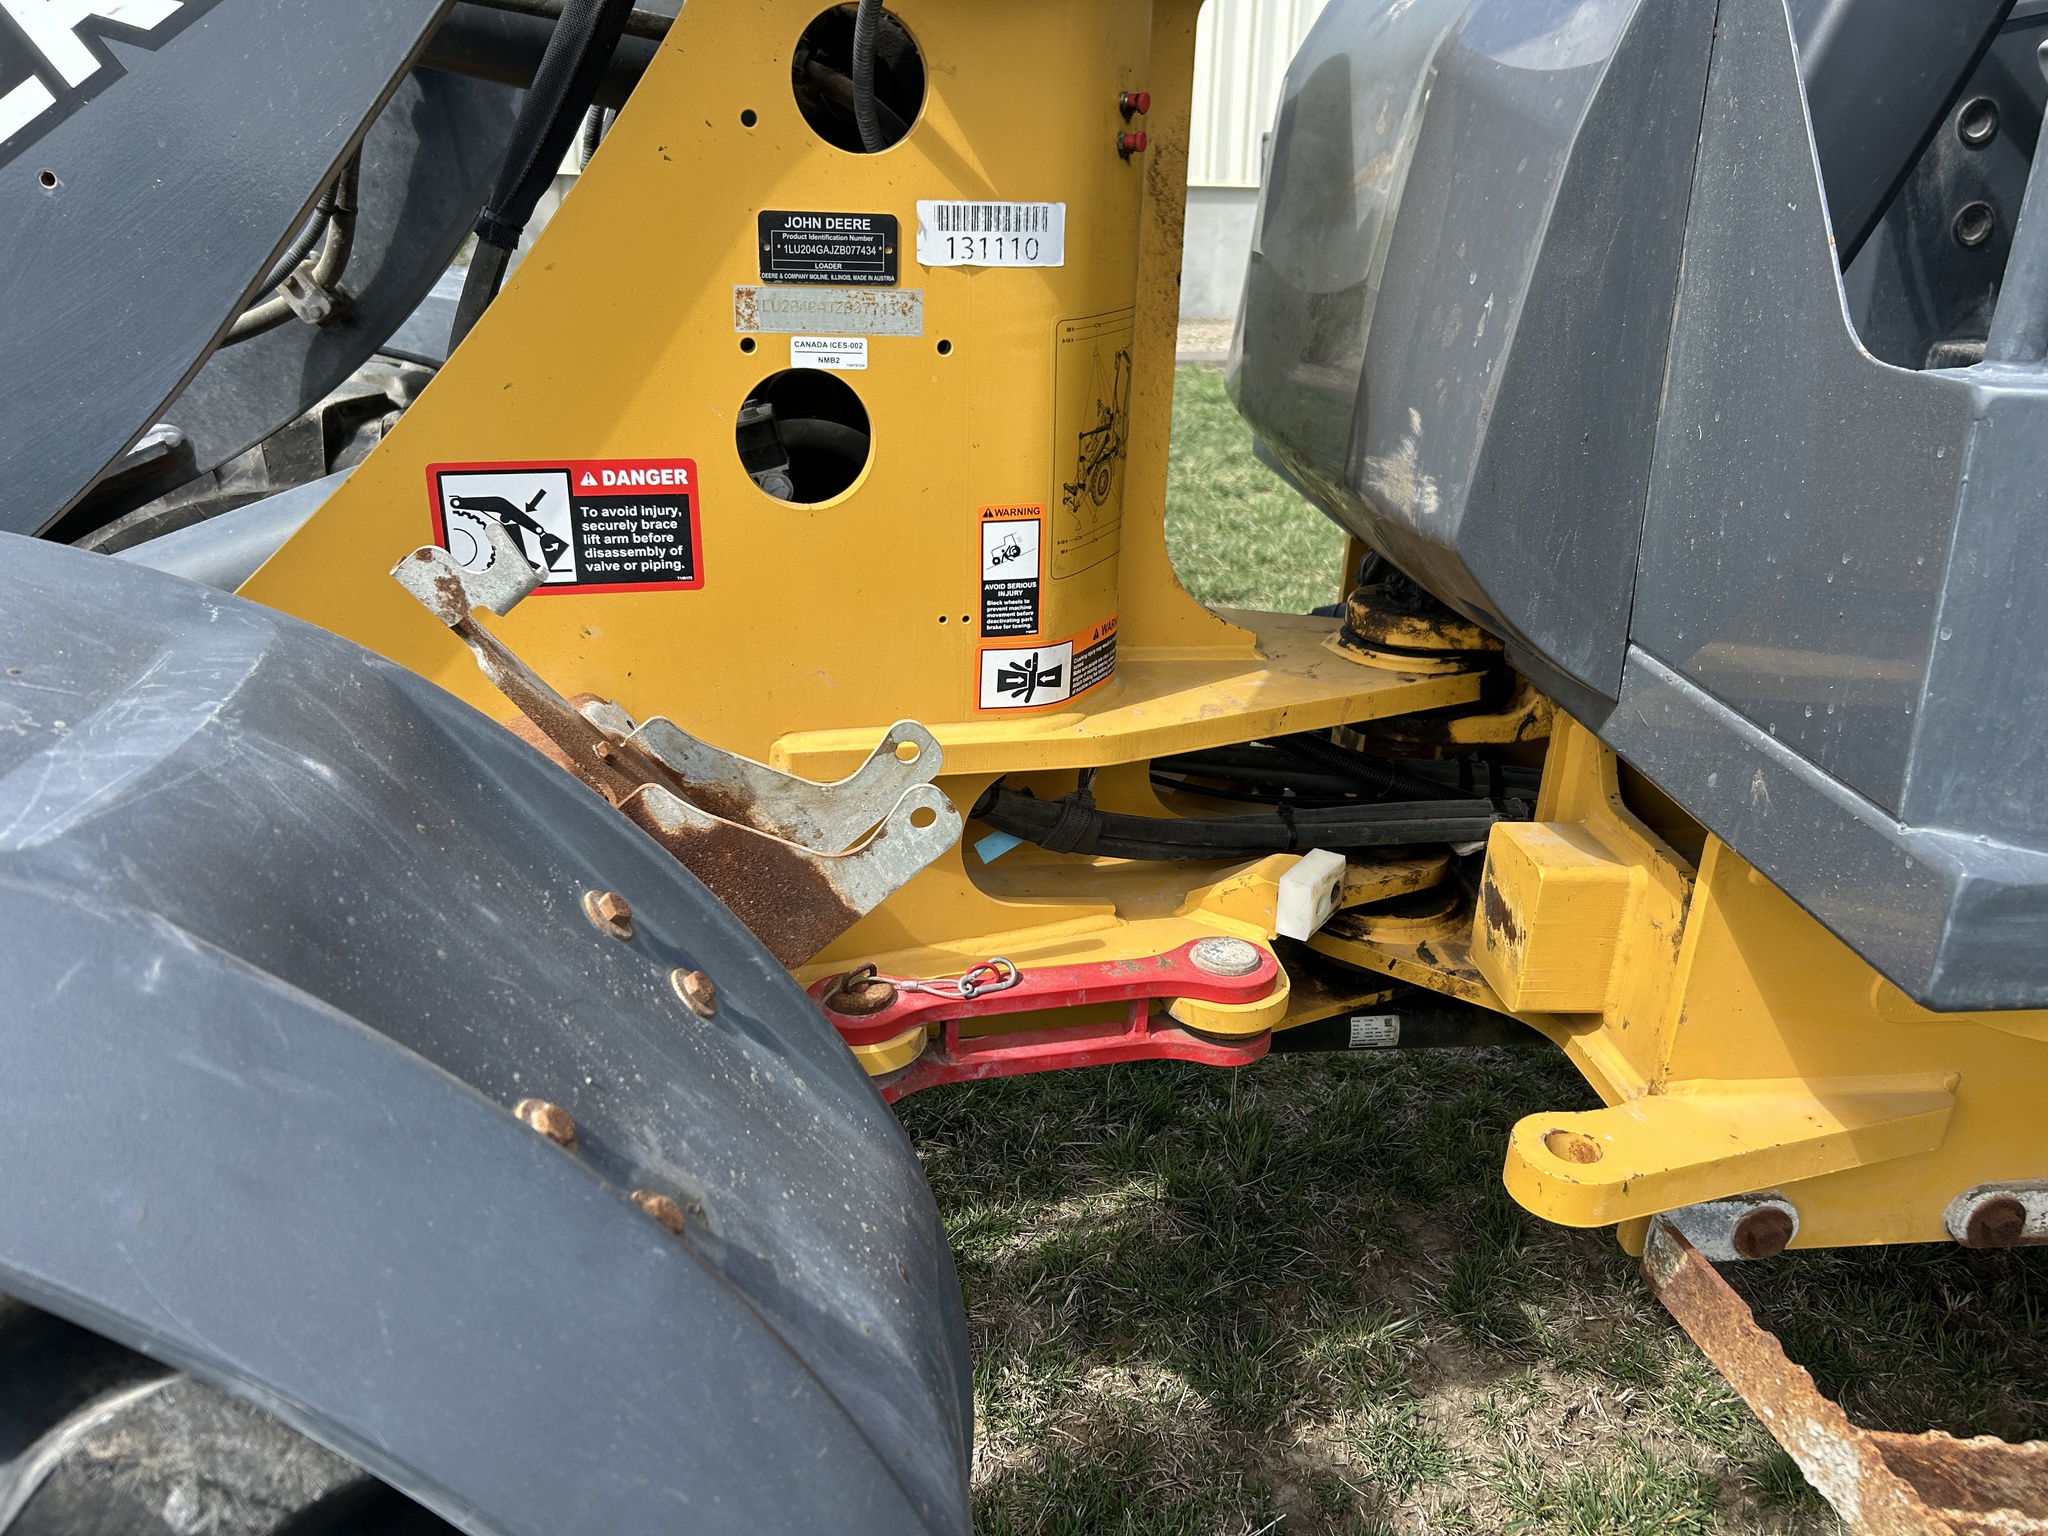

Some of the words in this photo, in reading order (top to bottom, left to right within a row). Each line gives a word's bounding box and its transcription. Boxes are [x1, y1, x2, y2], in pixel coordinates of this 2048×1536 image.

[785, 217, 824, 229] JOHN
[826, 218, 870, 230] DEERE
[784, 245, 876, 255] 1LU204GAJZB077434
[946, 237, 1039, 260] 131110
[602, 469, 688, 486] DANGER
[580, 507, 598, 517] To
[601, 506, 638, 517] avoid
[641, 505, 682, 518] injury,
[995, 507, 1040, 517] WARNING
[582, 520, 638, 532] securely
[641, 520, 678, 530] brace
[583, 534, 601, 545] lift
[604, 535, 630, 544] arm
[632, 533, 674, 543] before
[585, 547, 666, 558] disassembly
[669, 546, 683, 556] of
[586, 562, 621, 572] valve
[624, 562, 638, 571] or
[641, 560, 685, 573] piping.
